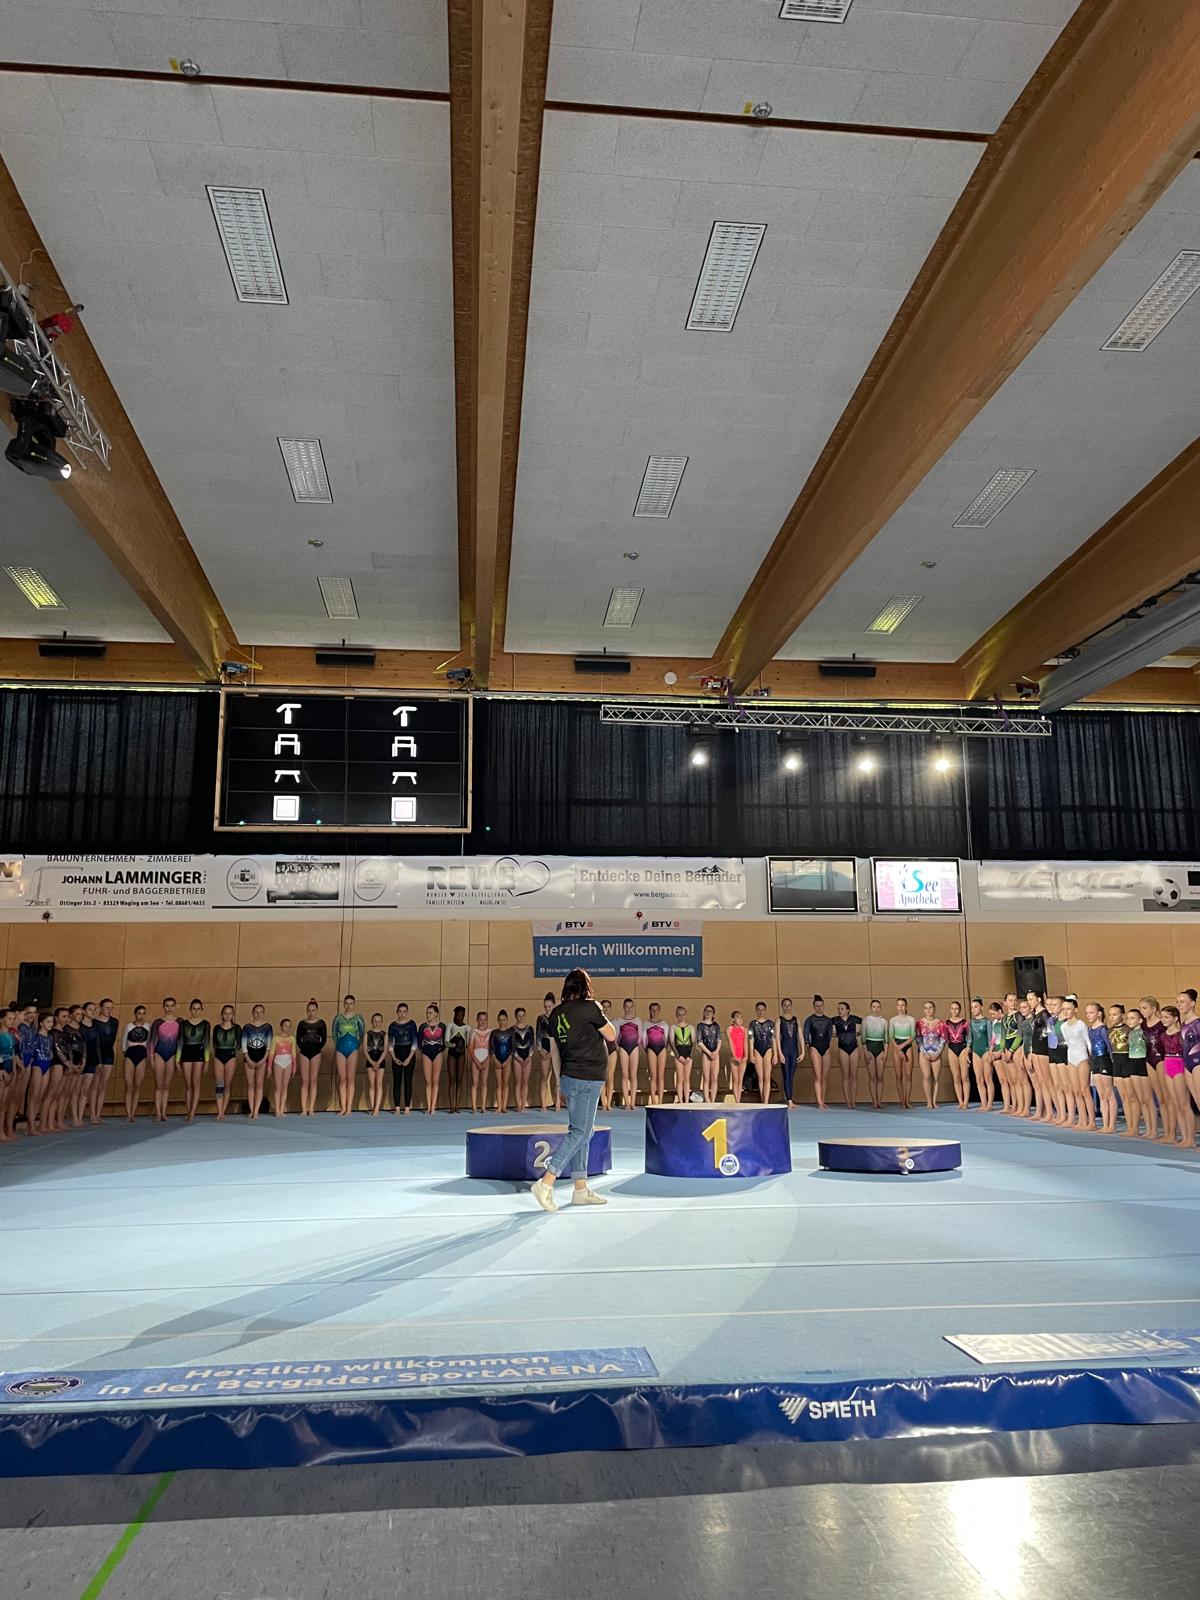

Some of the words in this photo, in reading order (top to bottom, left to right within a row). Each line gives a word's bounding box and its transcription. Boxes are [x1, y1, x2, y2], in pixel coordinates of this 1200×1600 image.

[46, 855, 136, 863] BAUUNTERNEHMEN
[147, 855, 192, 863] ZIMMEREI
[61, 875, 103, 884] JOHANN
[105, 871, 202, 884] LAMMINGER
[427, 866, 516, 889] REWE
[579, 869, 640, 882] Entdecke
[644, 870, 680, 882] Deine
[685, 870, 743, 885] Bergader
[82, 887, 110, 895] FUHR-
[113, 887, 130, 895] und
[132, 887, 206, 895] BAGGERBETRIEB
[899, 893, 939, 907] Apotheke
[539, 943, 597, 956] Herzlich
[602, 943, 695, 956] Willkommen!
[701, 1118, 728, 1169] 1
[533, 1140, 551, 1168] 2
[184, 1363, 332, 1379] Herzlich
[342, 1355, 550, 1372] willkommen
[97, 1384, 132, 1395] in
[143, 1381, 207, 1393] der
[216, 1374, 388, 1390] Bergader
[396, 1363, 625, 1382] SportARENA
[808, 1399, 877, 1419] SPIETH
